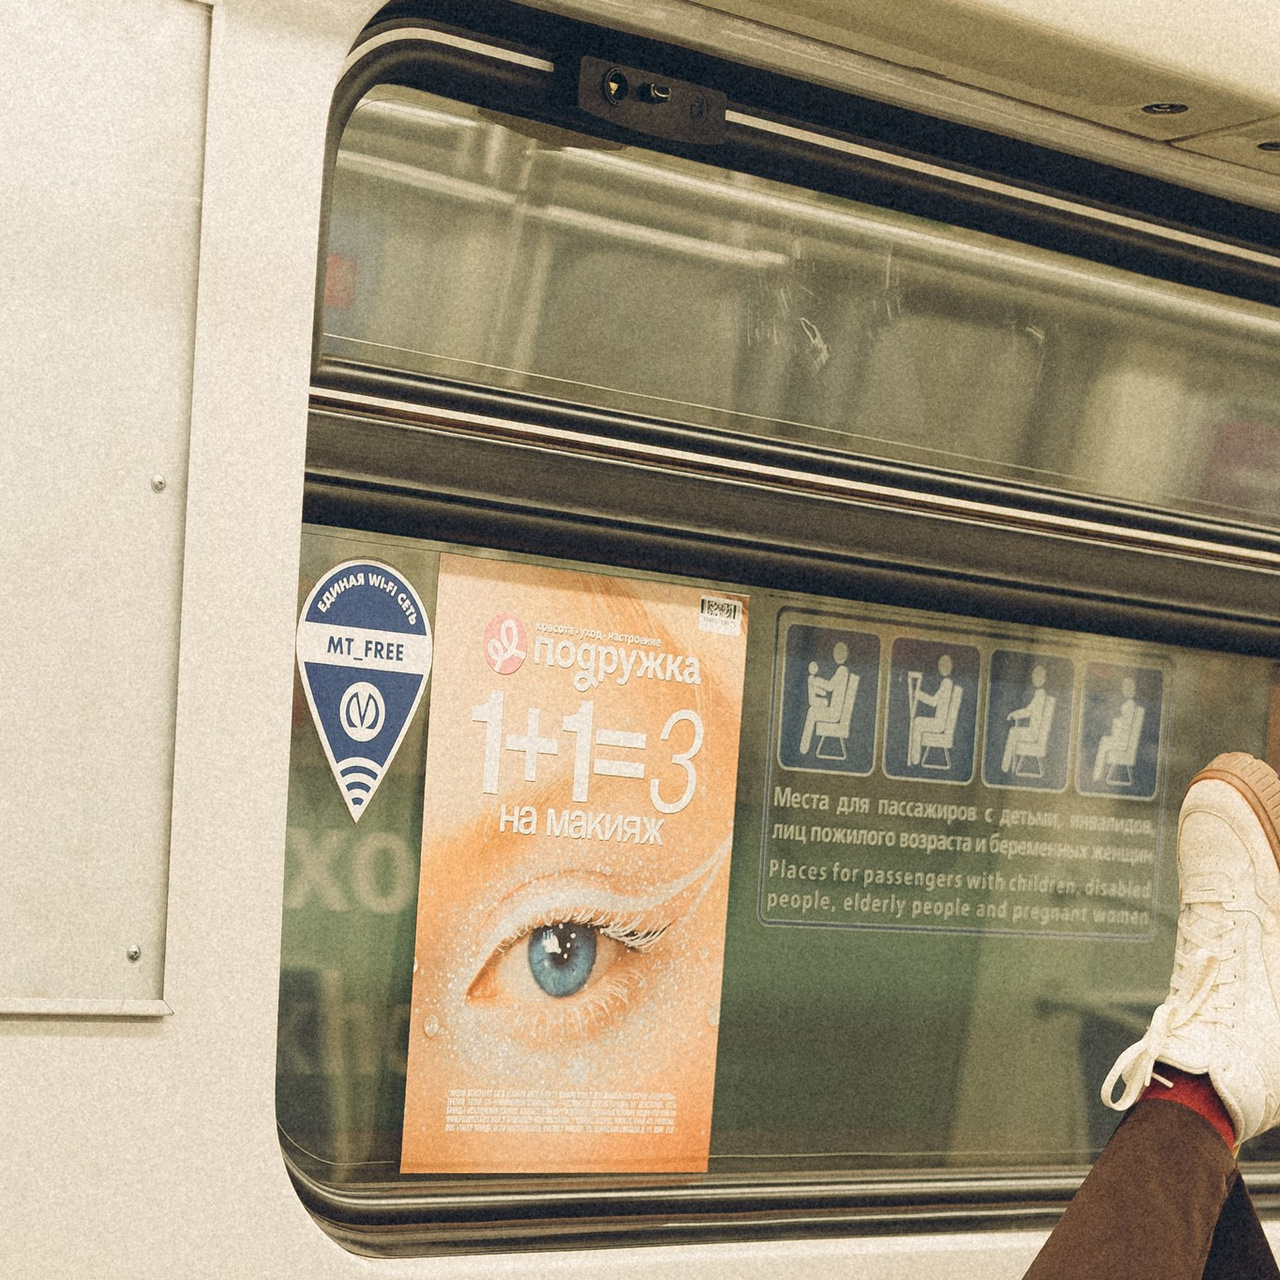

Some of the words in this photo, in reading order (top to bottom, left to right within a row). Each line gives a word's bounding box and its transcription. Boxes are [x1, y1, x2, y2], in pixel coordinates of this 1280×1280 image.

[317, 573, 365, 613] ЕДИНАЯ
[368, 573, 398, 597] WI-FI
[397, 593, 418, 625] СЕТЬ
[327, 636, 404, 661] MT_FREE
[536, 622, 574, 636] красота
[580, 628, 602, 640] уход
[608, 632, 662, 647] настроение
[534, 636, 702, 692] подружка
[472, 690, 704, 814] 1+1=3
[499, 804, 538, 835] на
[546, 808, 665, 845] макияж
[773, 786, 829, 811] Места
[836, 796, 870, 815] для
[878, 799, 977, 825] пассажиров
[984, 807, 995, 823] с
[771, 823, 807, 845] лиц
[810, 825, 897, 847] пожилого
[899, 832, 972, 854] возраста
[975, 837, 987, 853] и
[989, 833, 1088, 861] беременных
[1091, 846, 1154, 866] женщин
[768, 859, 828, 882] Places
[832, 862, 860, 882] for
[863, 869, 963, 892] passengers
[966, 871, 1005, 891] with
[1008, 873, 1082, 897] children,
[1084, 879, 1151, 899] disabled
[766, 891, 836, 913] people,
[843, 892, 906, 918] elderly
[911, 898, 971, 920] people
[976, 901, 1009, 919] and
[1012, 904, 1088, 925] pregnant
[1092, 910, 1150, 925] women
